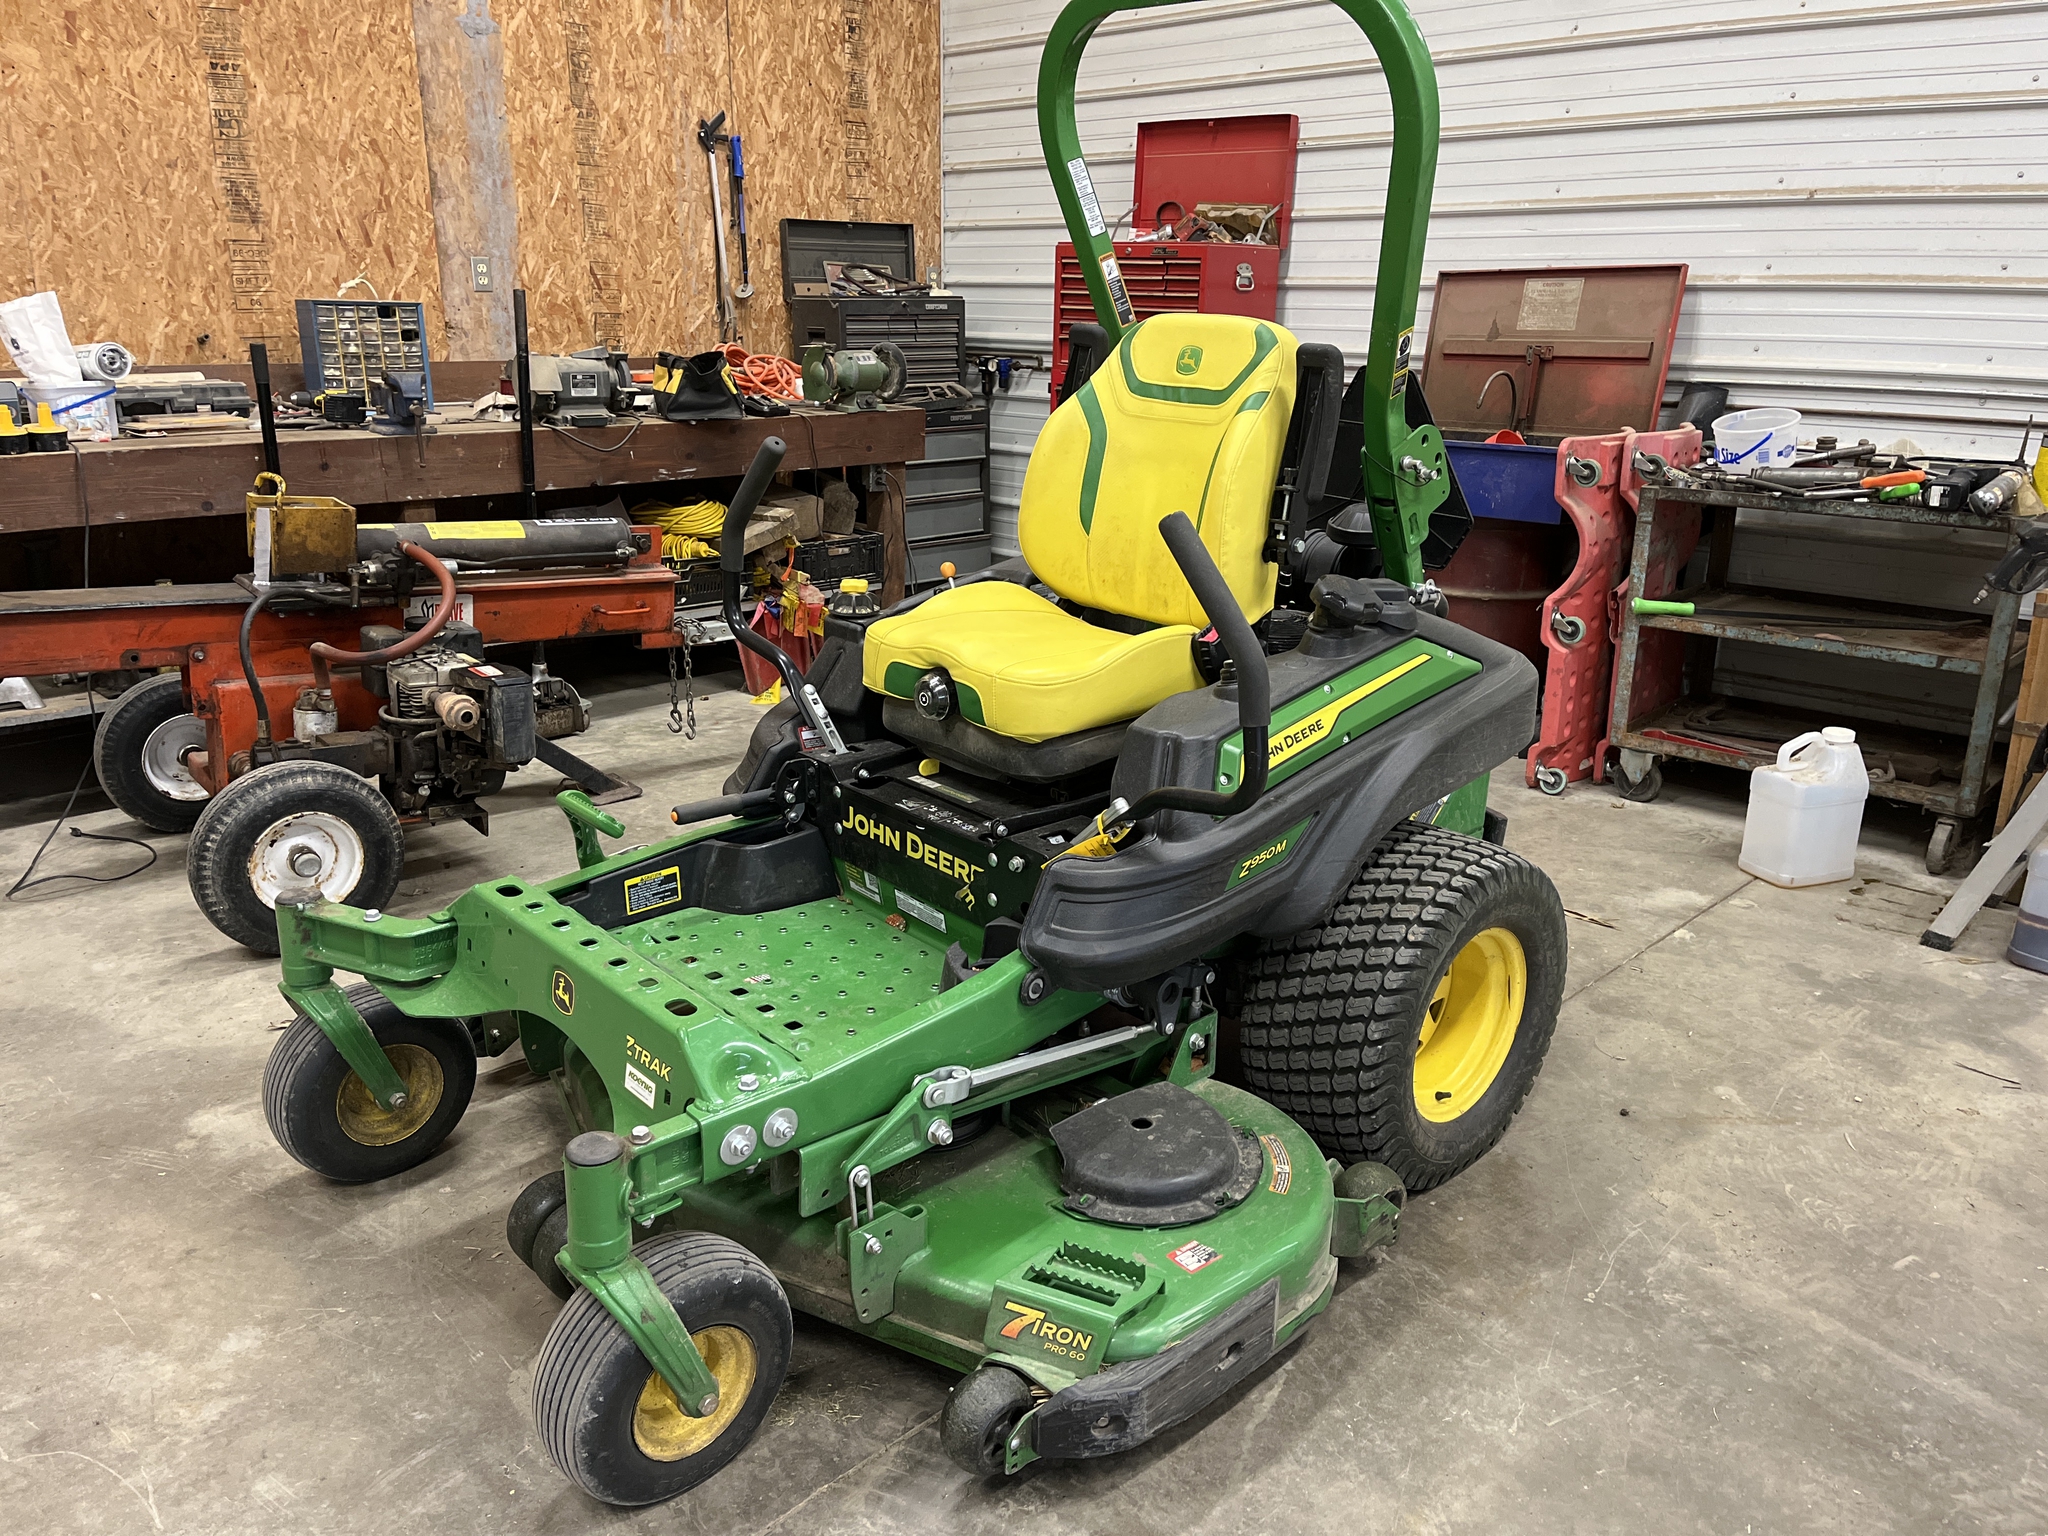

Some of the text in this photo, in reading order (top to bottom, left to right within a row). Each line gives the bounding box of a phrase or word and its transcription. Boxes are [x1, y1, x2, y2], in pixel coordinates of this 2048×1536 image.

[209, 61, 241, 72] APA
[1720, 447, 1741, 465] Size
[1283, 718, 1325, 749] DEERE
[842, 805, 901, 852] JOHN
[1238, 838, 1288, 879] Z950M
[1030, 1318, 1093, 1352] IRON
[1043, 1342, 1086, 1362] PRO 60
